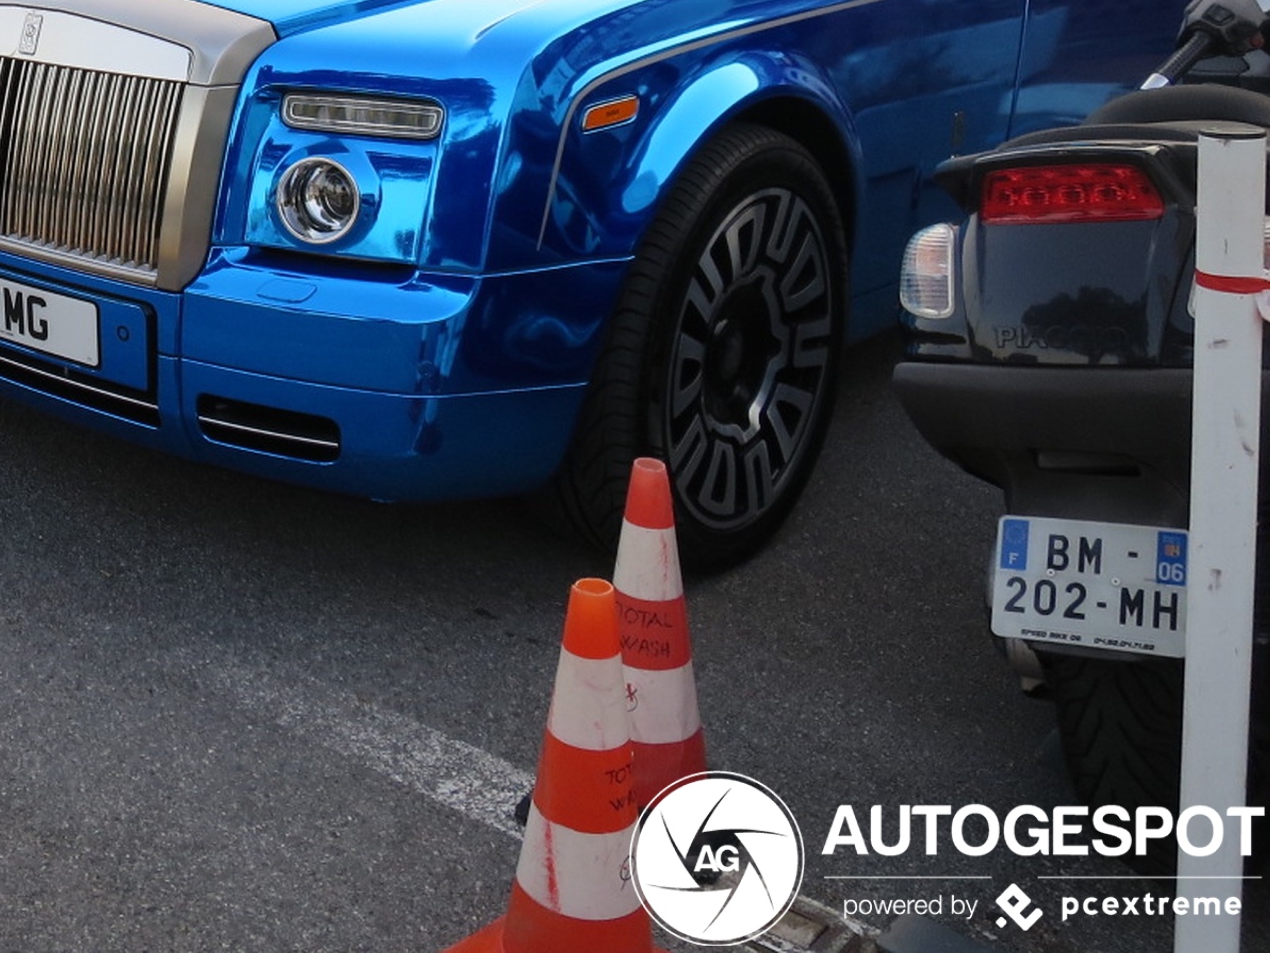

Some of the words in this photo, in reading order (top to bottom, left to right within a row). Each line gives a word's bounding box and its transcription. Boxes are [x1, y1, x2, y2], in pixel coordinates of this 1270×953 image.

[1008, 552, 1019, 566] F
[1047, 534, 1103, 575] BM
[1158, 563, 1185, 582] 06
[615, 601, 673, 628] TOTAL
[1004, 576, 1179, 632] 202-MH
[619, 635, 670, 657] WASH
